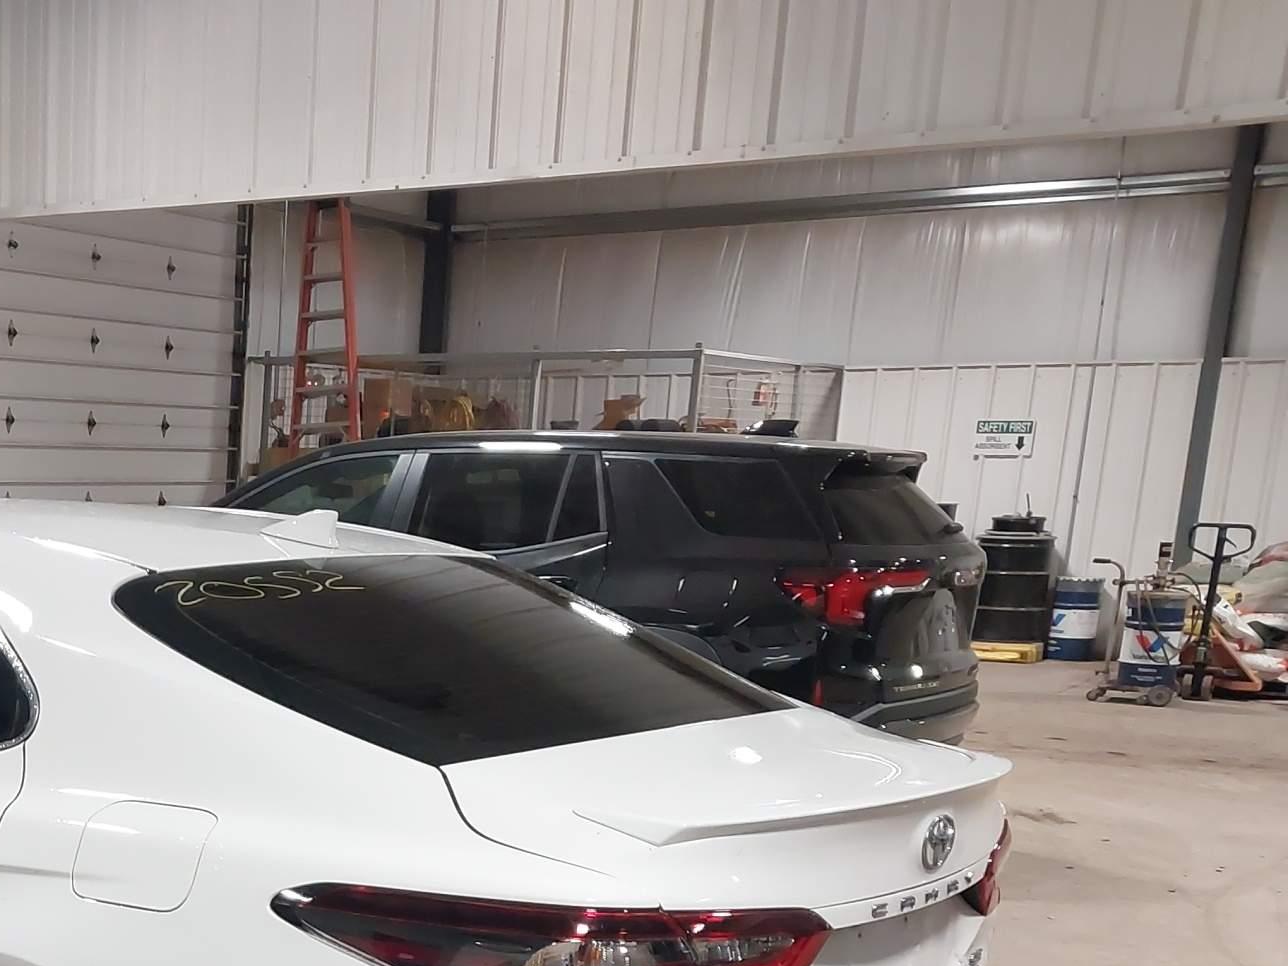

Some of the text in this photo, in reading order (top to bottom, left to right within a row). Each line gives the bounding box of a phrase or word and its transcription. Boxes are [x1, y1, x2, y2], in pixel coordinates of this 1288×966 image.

[978, 422, 1032, 432] SAFETY FIRST
[154, 569, 365, 606] 20552
